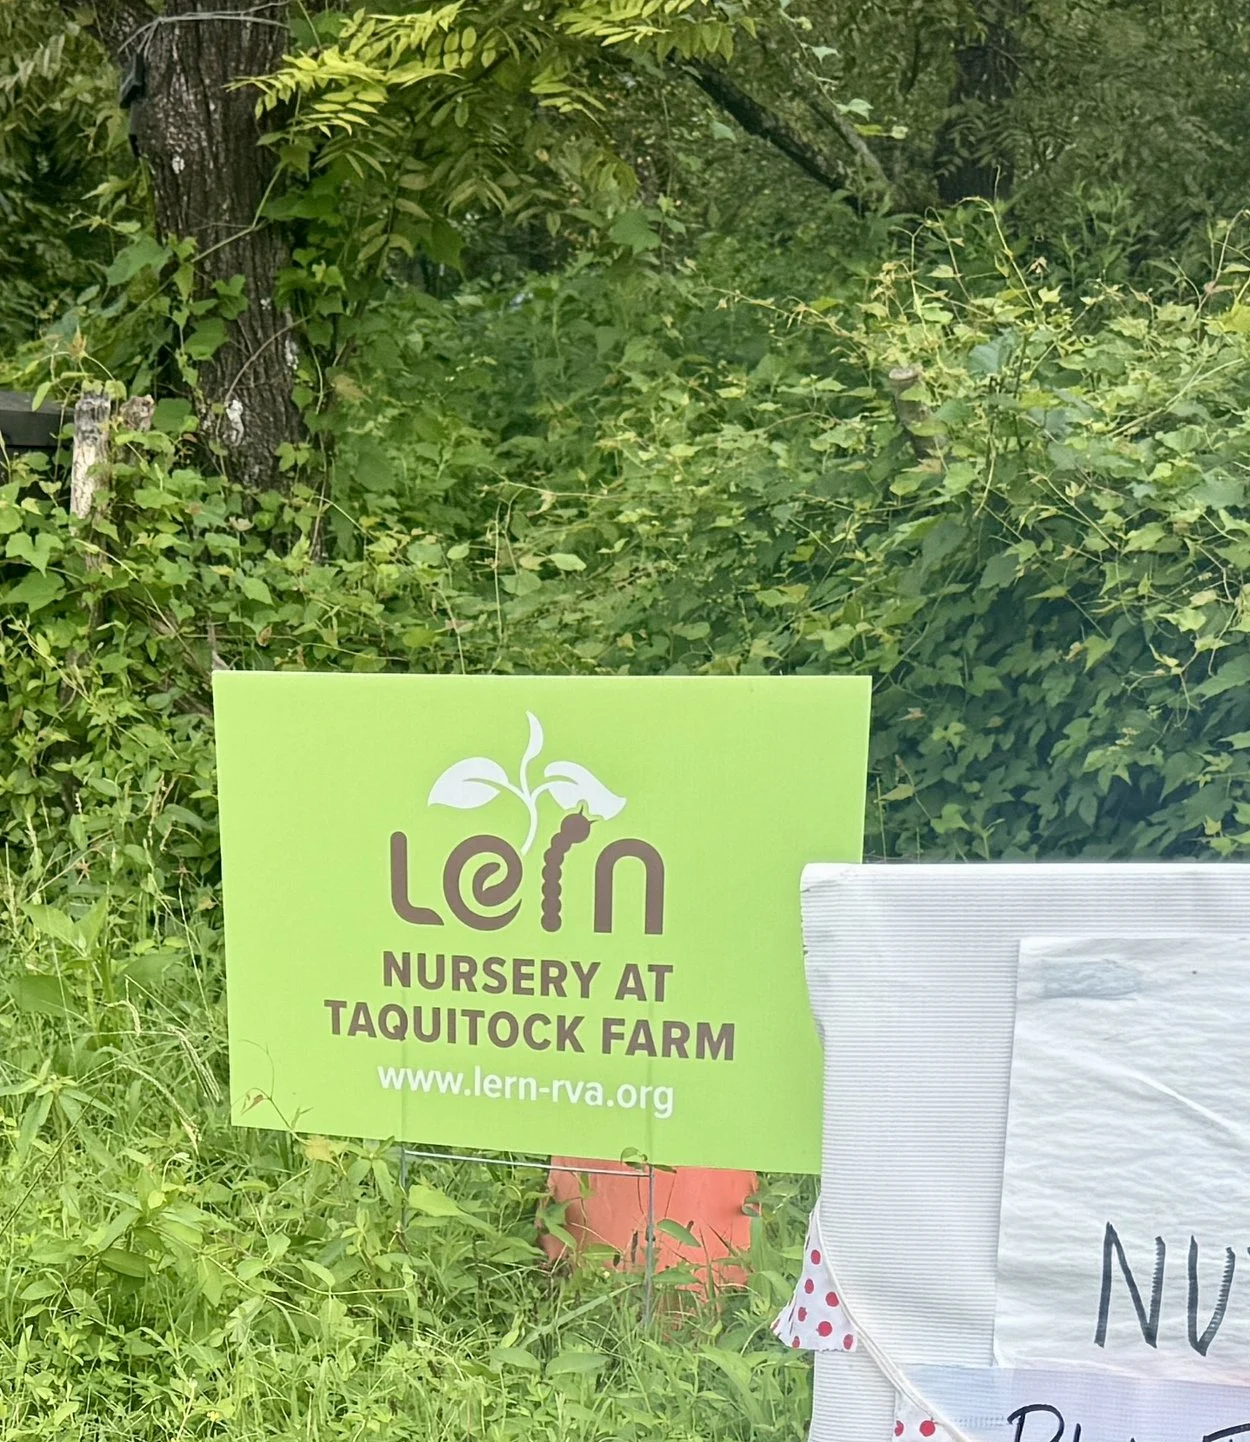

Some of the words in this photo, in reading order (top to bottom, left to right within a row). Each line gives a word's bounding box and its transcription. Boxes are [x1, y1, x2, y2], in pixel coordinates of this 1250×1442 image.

[382, 950, 601, 999] NURSERY
[615, 962, 674, 1003] AT
[324, 999, 586, 1054] TAQUITOCK
[601, 1017, 736, 1061] FARM
[377, 1065, 674, 1119] www.lern-rva.org
